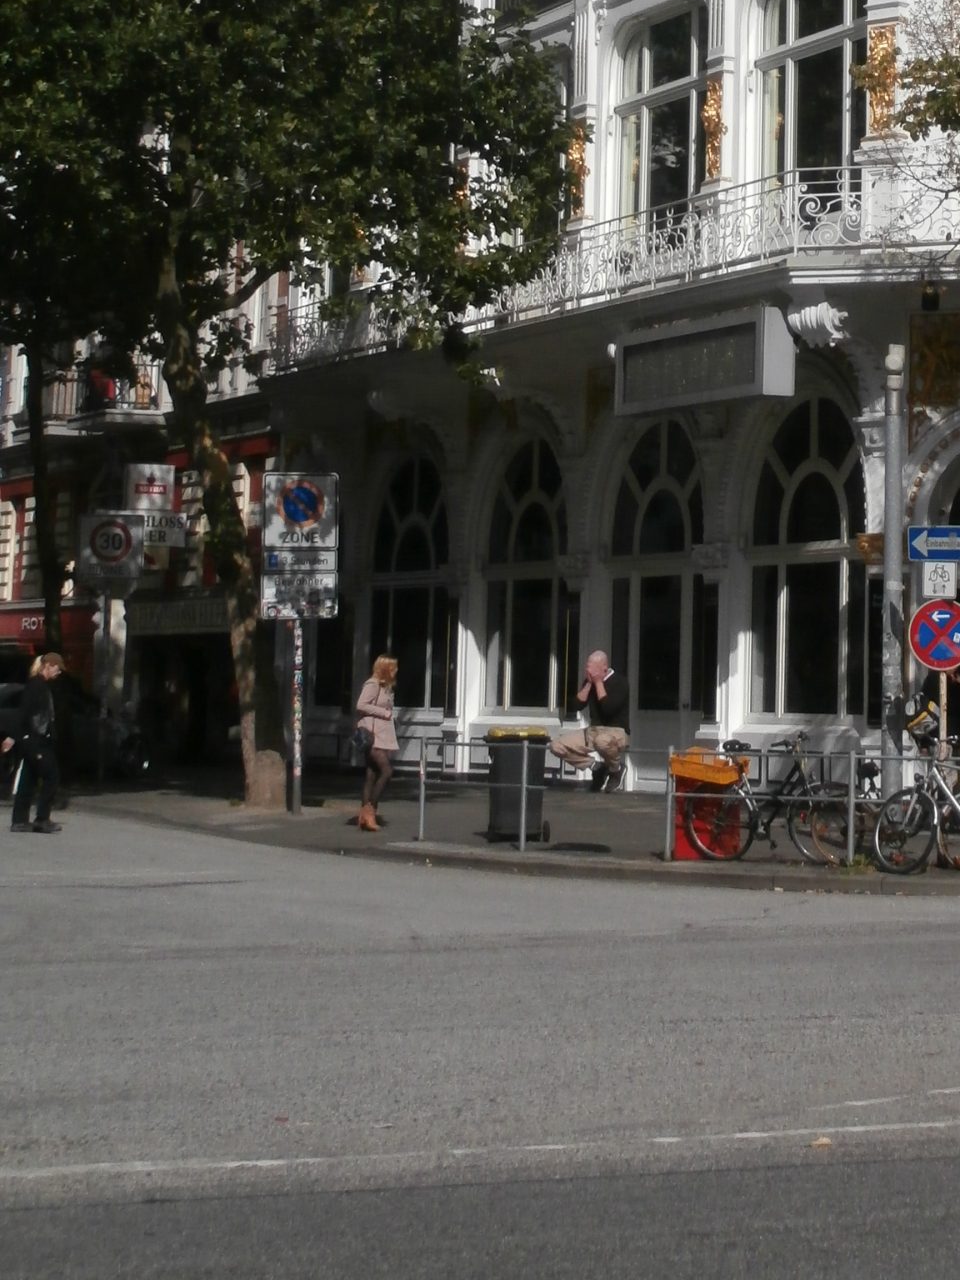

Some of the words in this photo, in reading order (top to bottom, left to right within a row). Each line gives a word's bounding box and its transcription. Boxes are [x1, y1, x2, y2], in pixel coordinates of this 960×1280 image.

[99, 532, 123, 550] 30
[281, 531, 320, 544] ZONE
[282, 556, 288, 565] 3
[291, 555, 329, 566] Stunden
